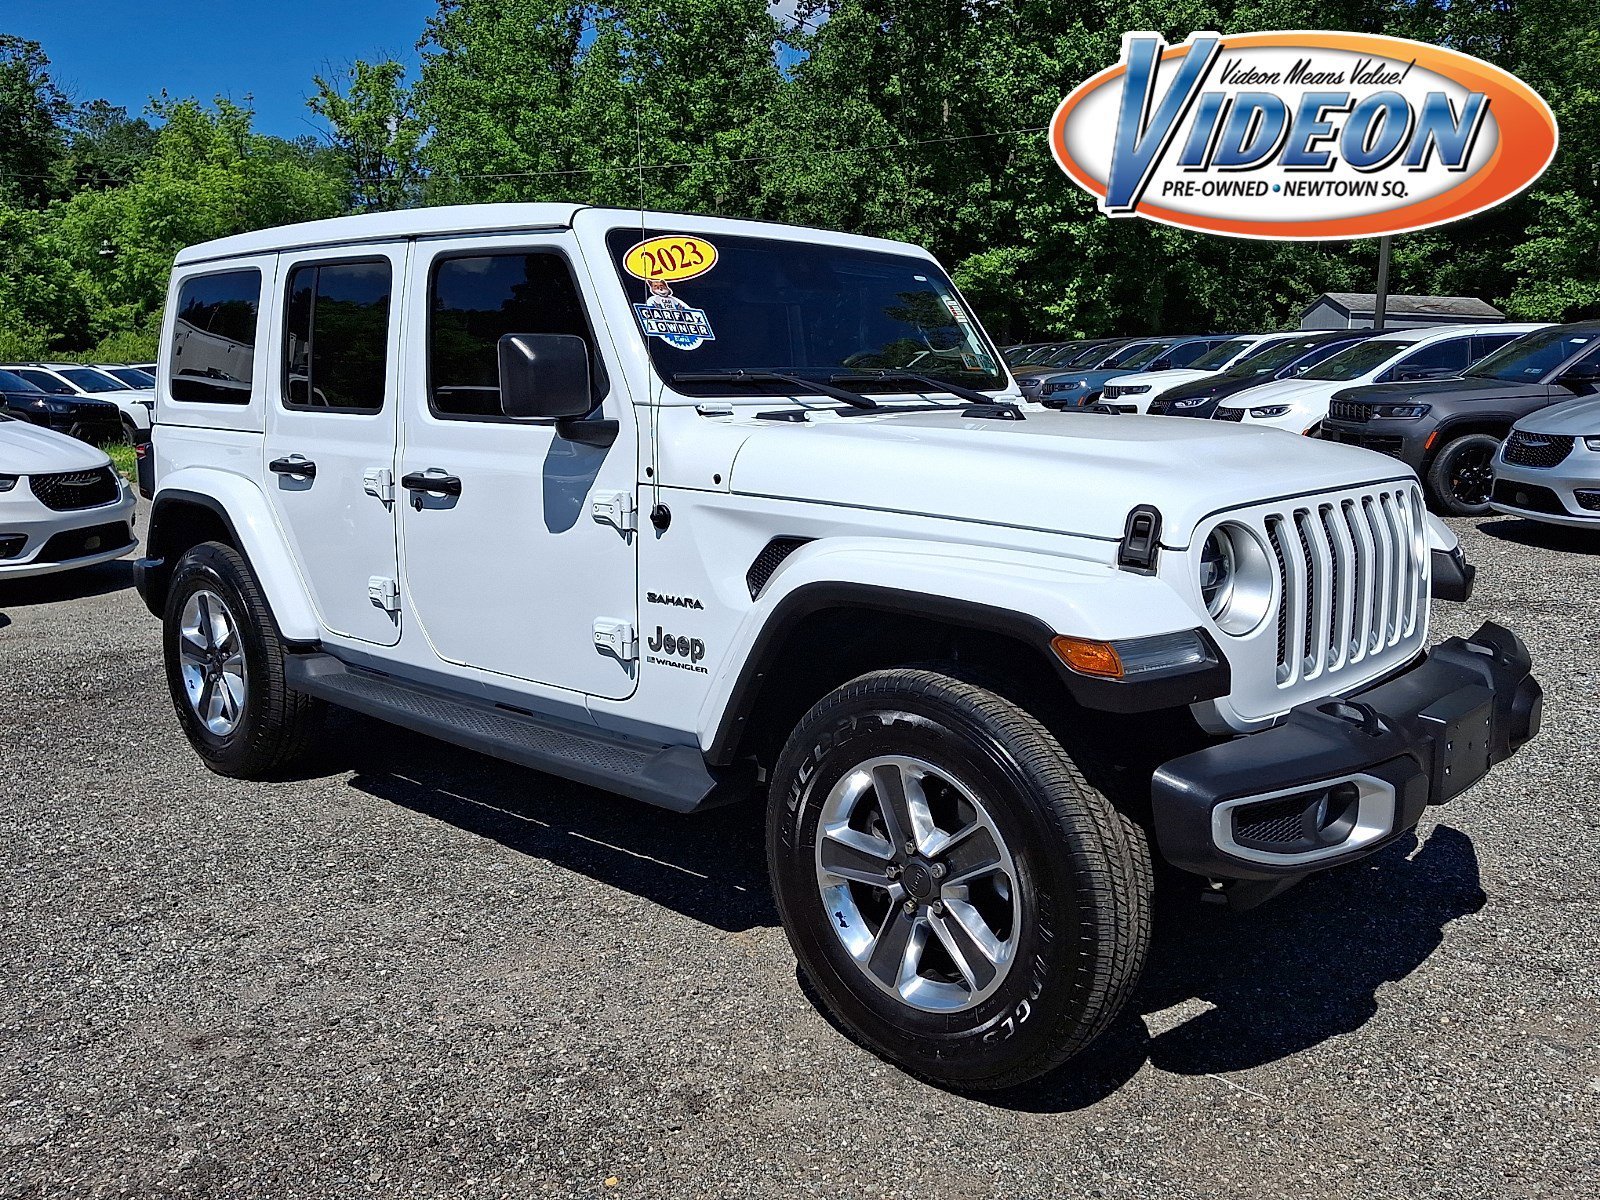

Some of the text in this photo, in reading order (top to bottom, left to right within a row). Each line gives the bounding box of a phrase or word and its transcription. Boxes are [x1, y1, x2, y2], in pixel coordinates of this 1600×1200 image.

[641, 242, 704, 276] 2023
[641, 309, 705, 324] CARFAX
[657, 322, 708, 335] OWNER
[647, 592, 704, 610] SAHARA
[648, 626, 705, 664] Jeep
[656, 657, 708, 674] WRANGLER
